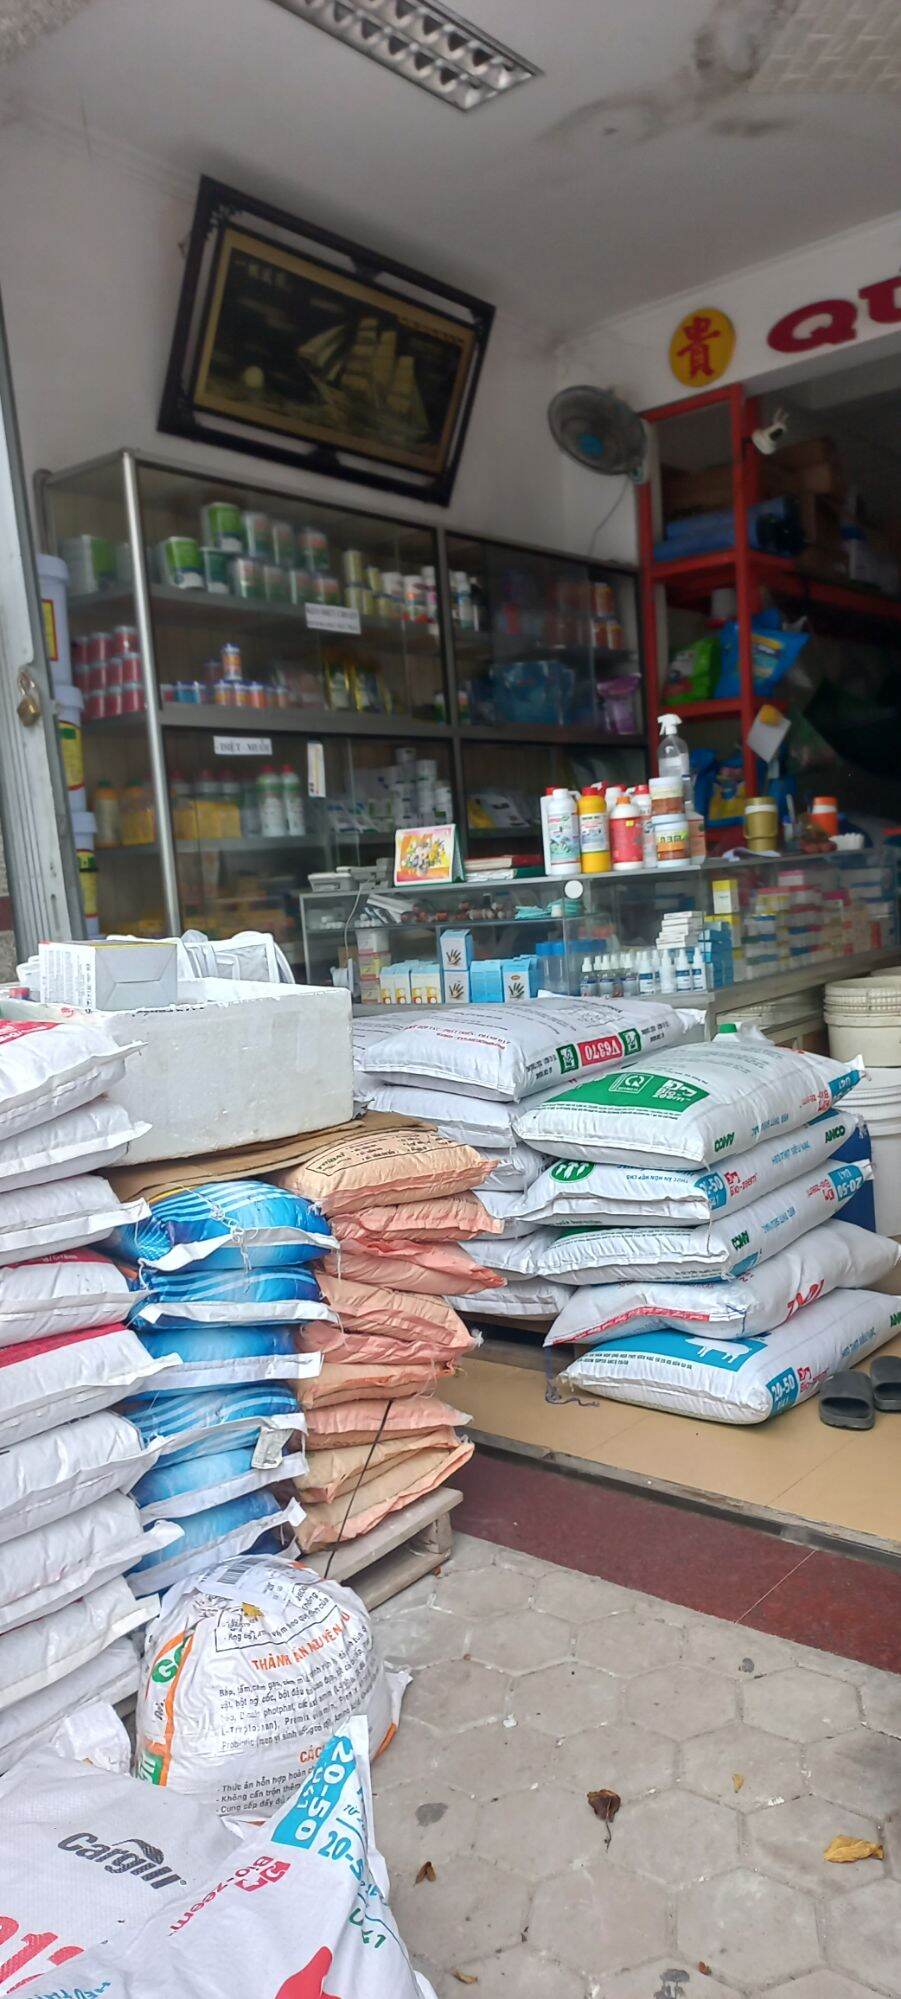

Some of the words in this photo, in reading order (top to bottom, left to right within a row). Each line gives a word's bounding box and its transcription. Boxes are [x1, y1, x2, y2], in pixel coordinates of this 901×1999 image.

[584, 1040, 622, 1061] V6370
[771, 1374, 796, 1400] 20-50
[295, 1741, 353, 1841] 20-50
[57, 1832, 183, 1890] Cargill
